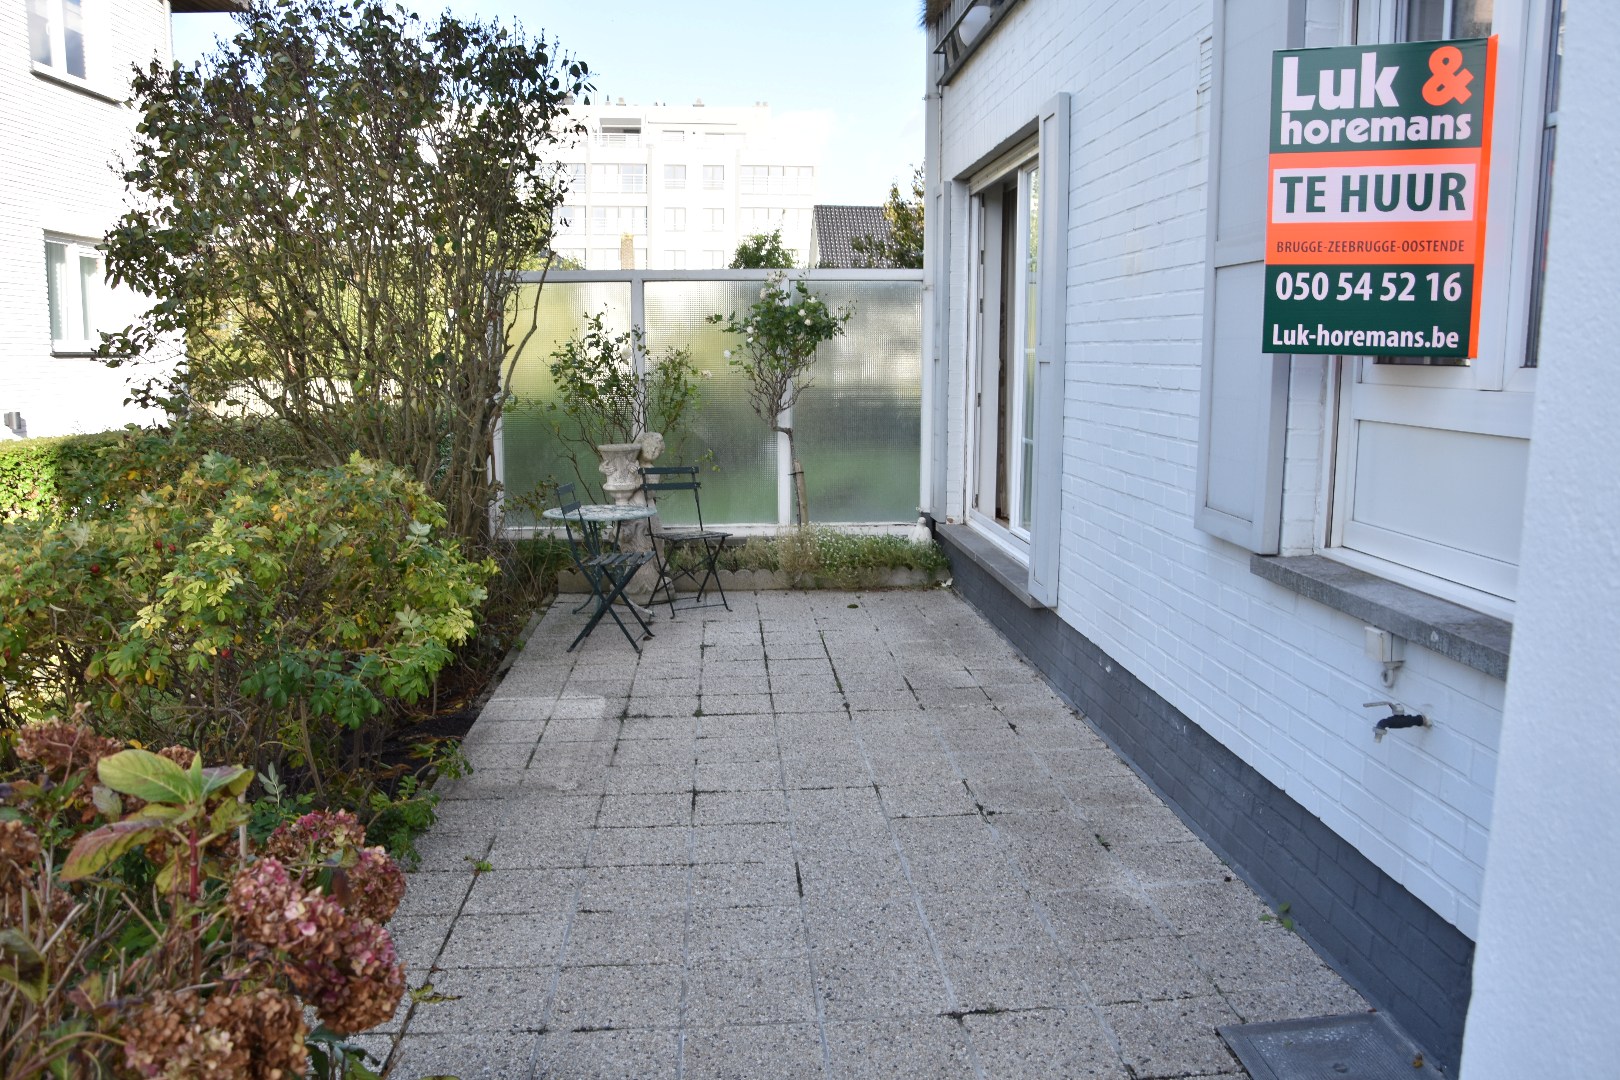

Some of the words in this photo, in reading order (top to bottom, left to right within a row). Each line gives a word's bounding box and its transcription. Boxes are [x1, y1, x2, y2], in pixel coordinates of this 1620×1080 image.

[1281, 52, 1400, 112] Luk
[1421, 45, 1475, 106] &
[1280, 112, 1472, 145] horemans
[1279, 175, 1327, 214] TE
[1340, 172, 1467, 213] HUUR
[1276, 240, 1465, 253] BRUGGE-ZEEBRUGGE-OOSTENDE
[1275, 271, 1329, 301] 050
[1336, 271, 1373, 301] 54
[1379, 271, 1416, 302] 52
[1425, 271, 1462, 302] 16
[1272, 323, 1459, 348] Luk-horemans.be
